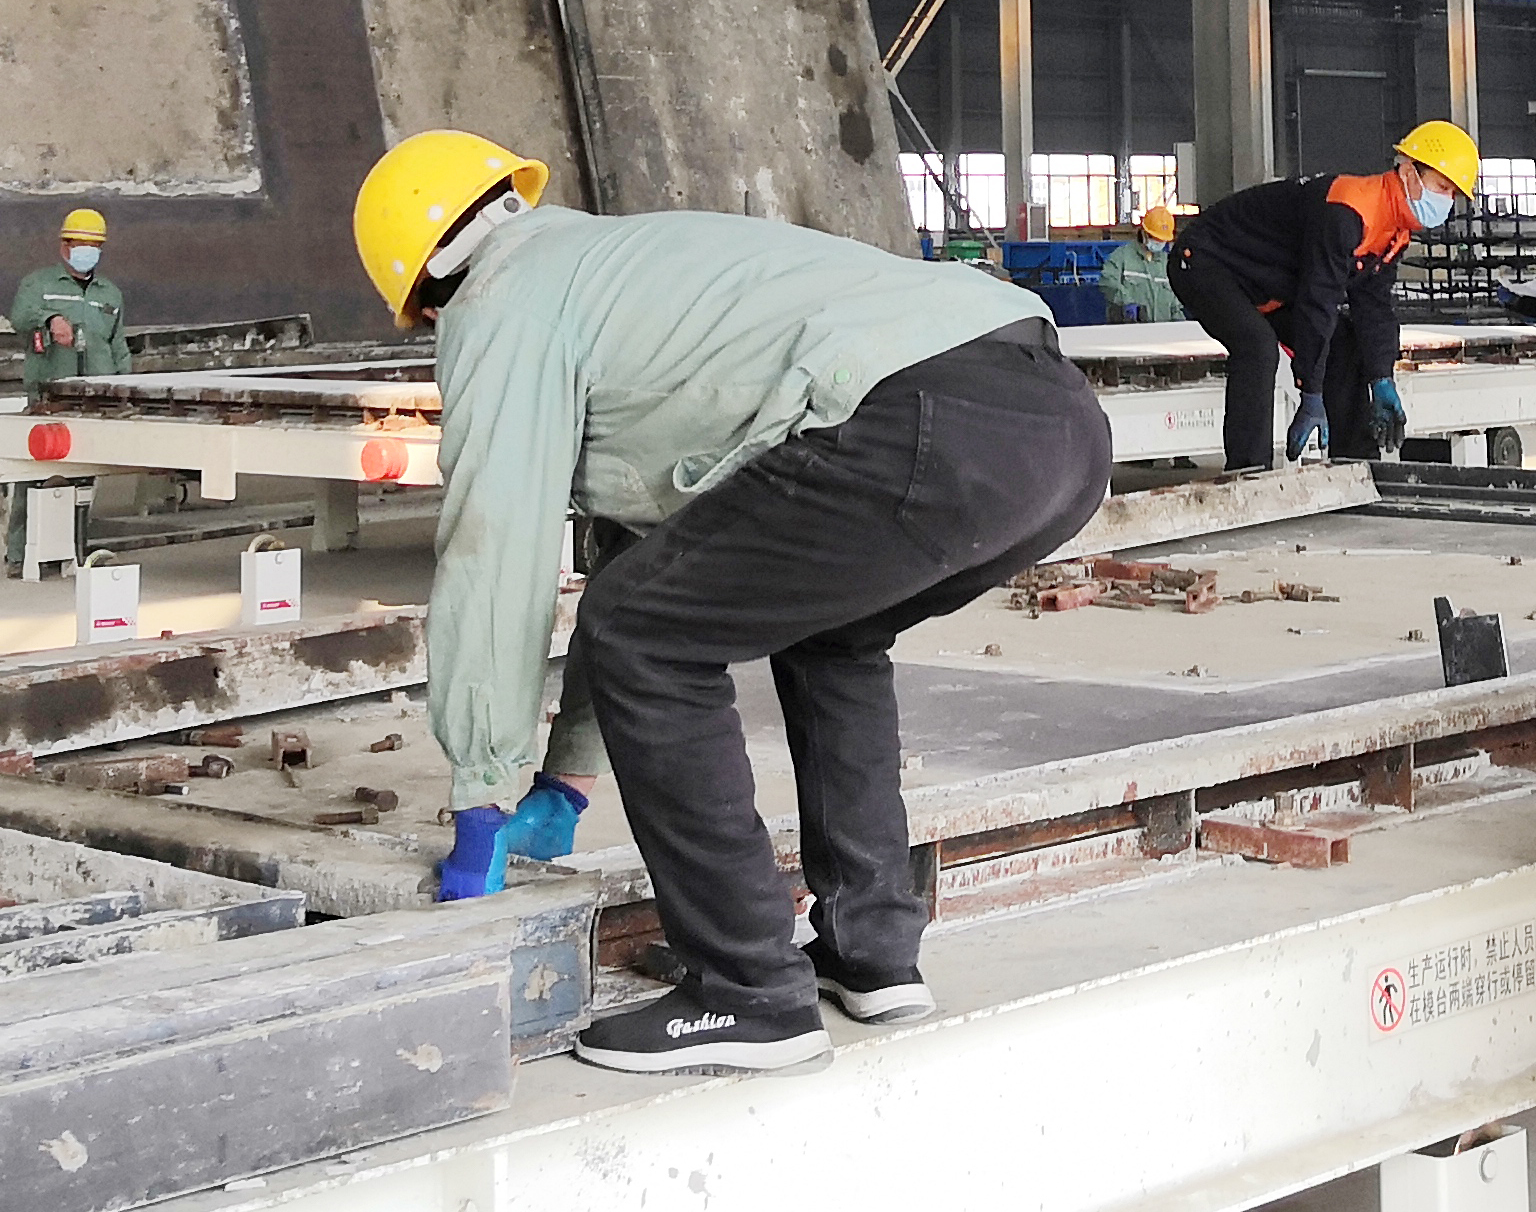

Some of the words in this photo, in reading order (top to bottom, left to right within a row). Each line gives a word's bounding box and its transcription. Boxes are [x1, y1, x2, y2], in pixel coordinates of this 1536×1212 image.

[1409, 958, 1536, 1026] 在模台两端穿行或停留
[666, 1011, 737, 1039] Fashion
